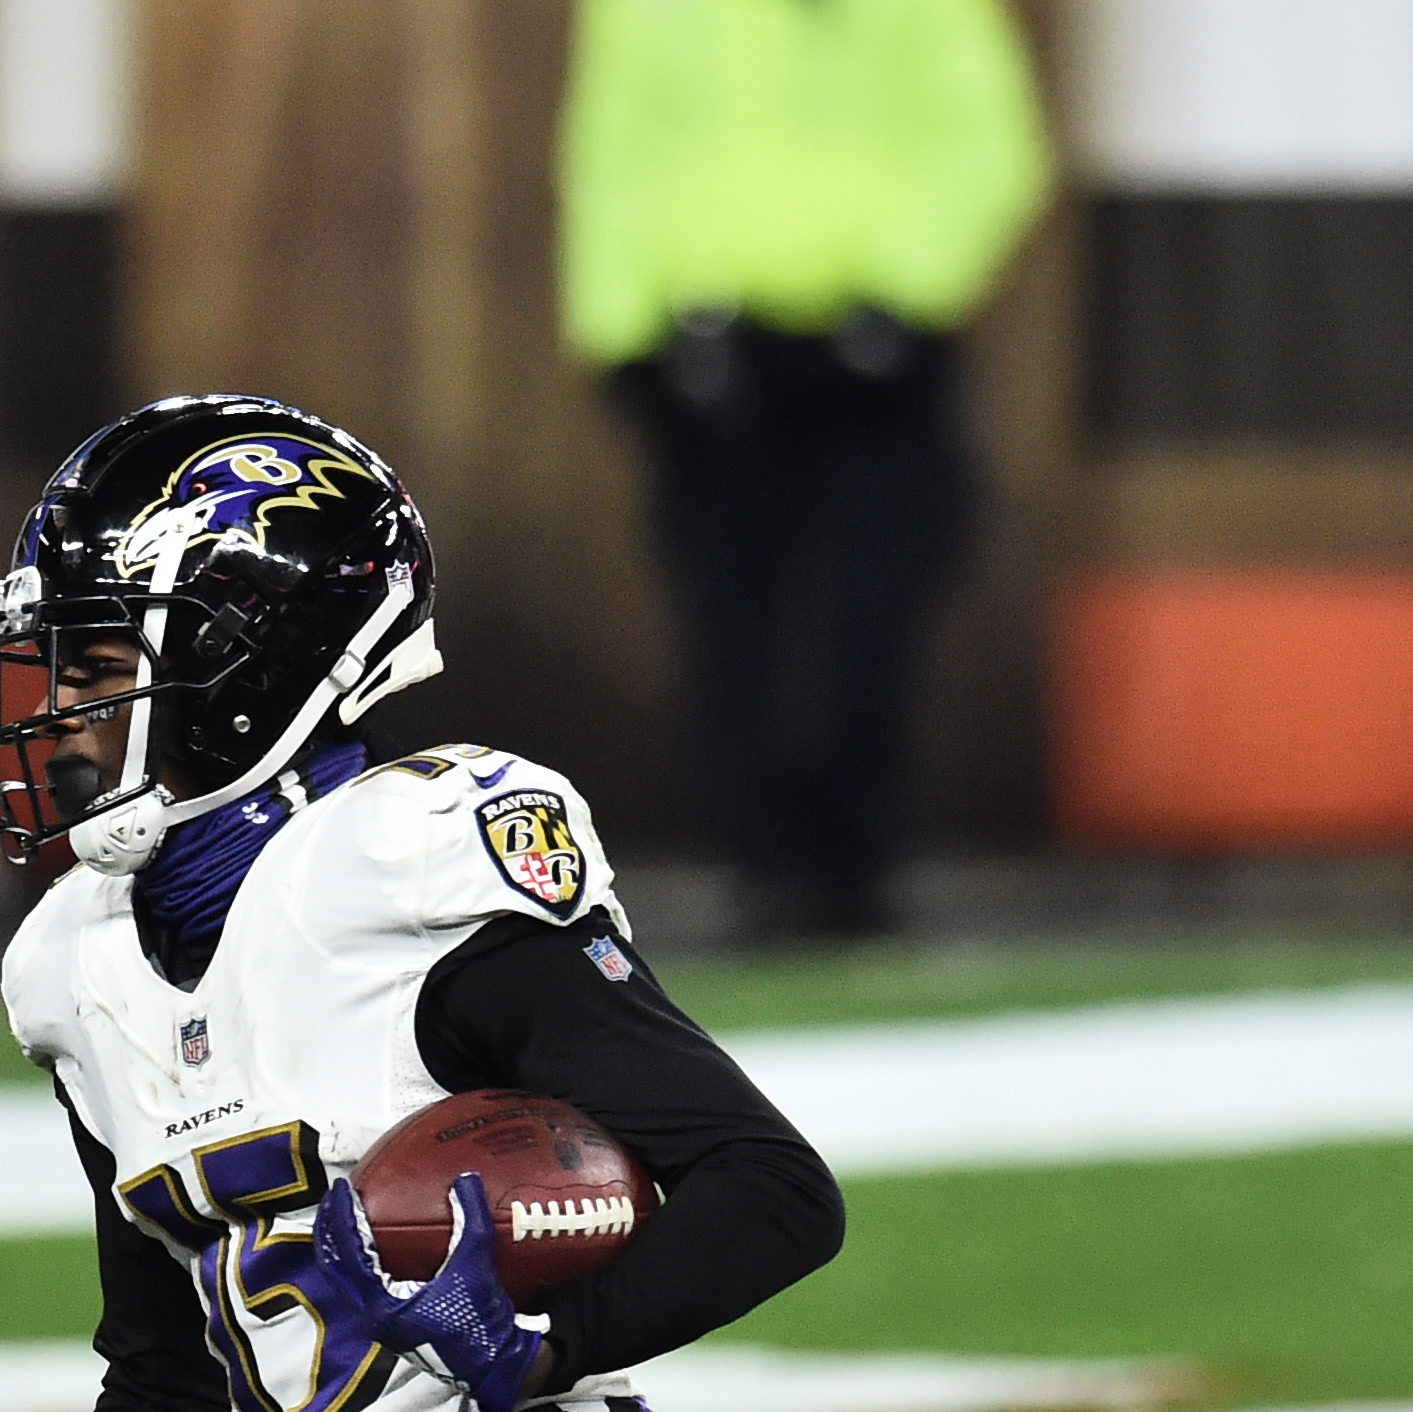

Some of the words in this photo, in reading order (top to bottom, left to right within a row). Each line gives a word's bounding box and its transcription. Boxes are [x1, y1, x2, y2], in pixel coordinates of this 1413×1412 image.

[192, 443, 302, 486] B
[480, 793, 561, 822] RAVENS
[489, 815, 535, 854] B
[543, 851, 580, 888] R
[599, 953, 629, 977] NFL
[183, 1036, 210, 1061] NFL
[164, 1098, 245, 1139] RAVENS
